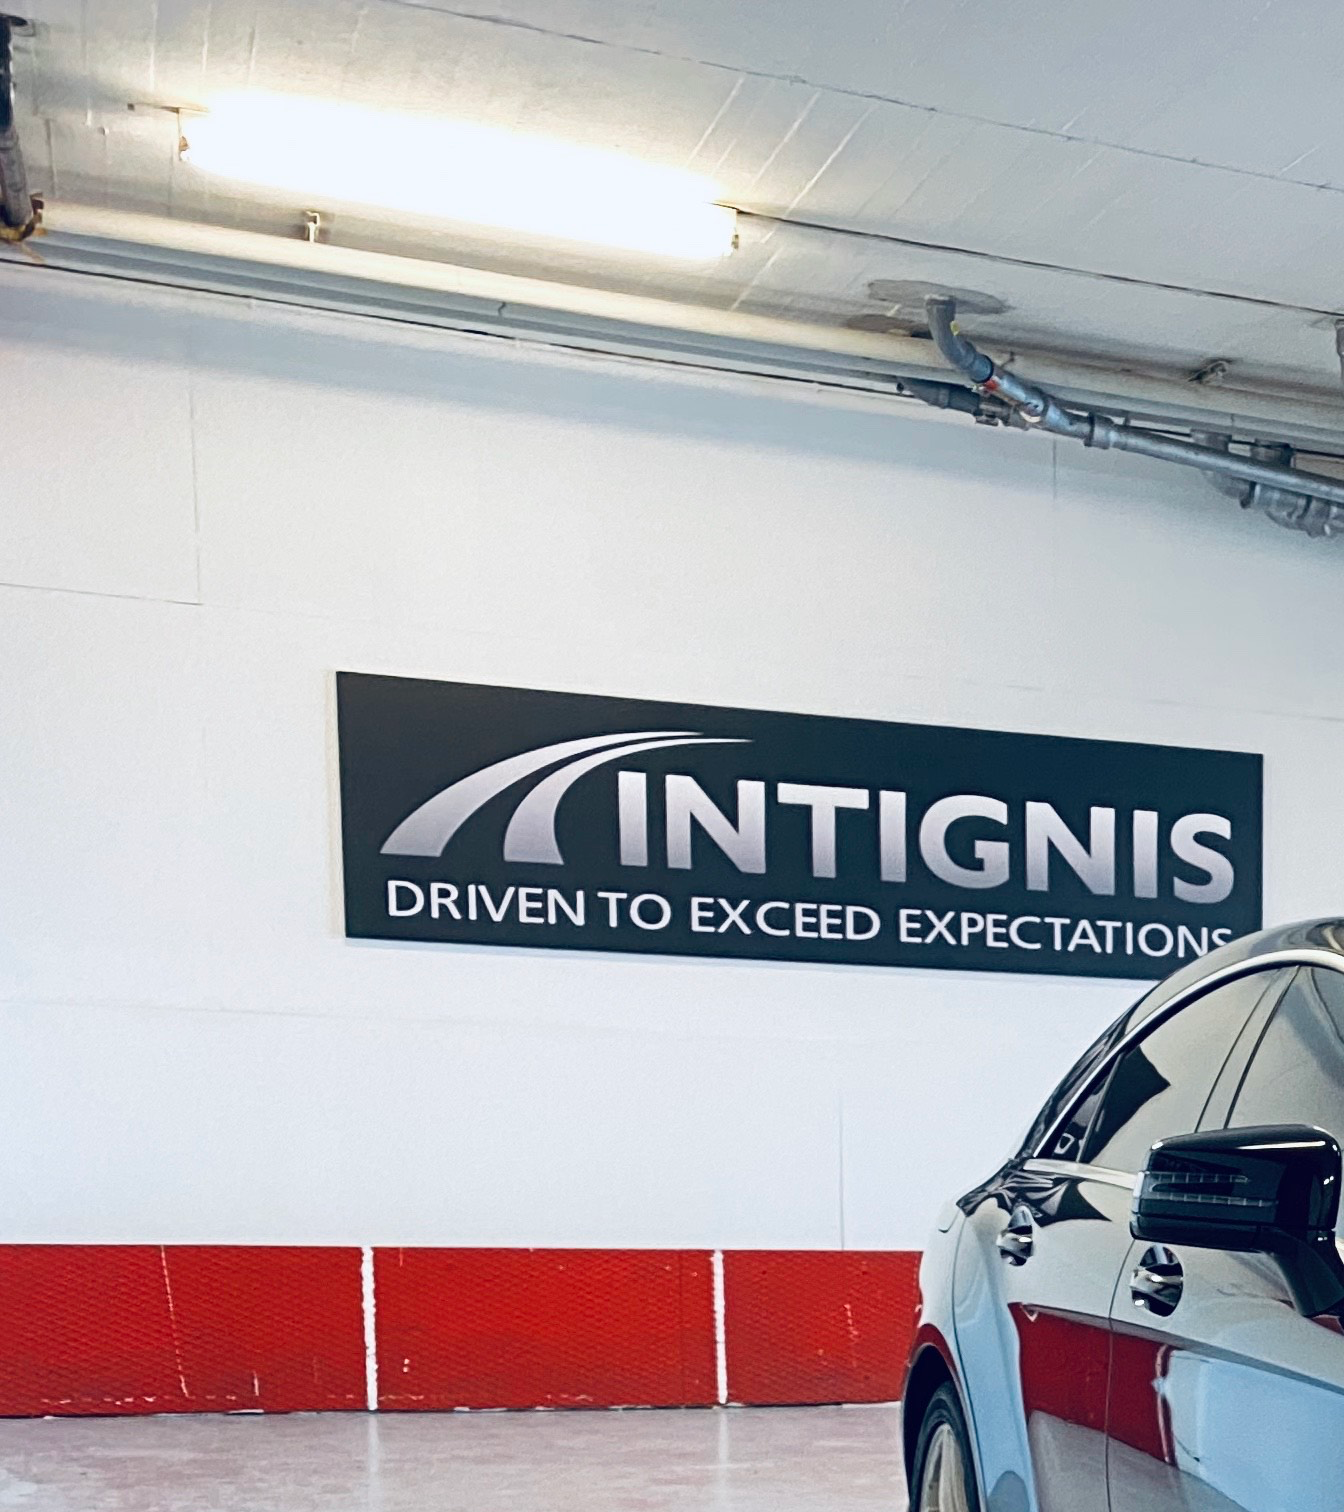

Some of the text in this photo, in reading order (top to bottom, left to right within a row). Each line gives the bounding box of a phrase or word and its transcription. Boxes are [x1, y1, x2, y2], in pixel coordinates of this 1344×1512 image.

[618, 771, 1235, 904] INTIGNIS
[387, 880, 586, 927] DRIVEN
[597, 892, 672, 931] TO
[690, 896, 881, 941] EXCEED
